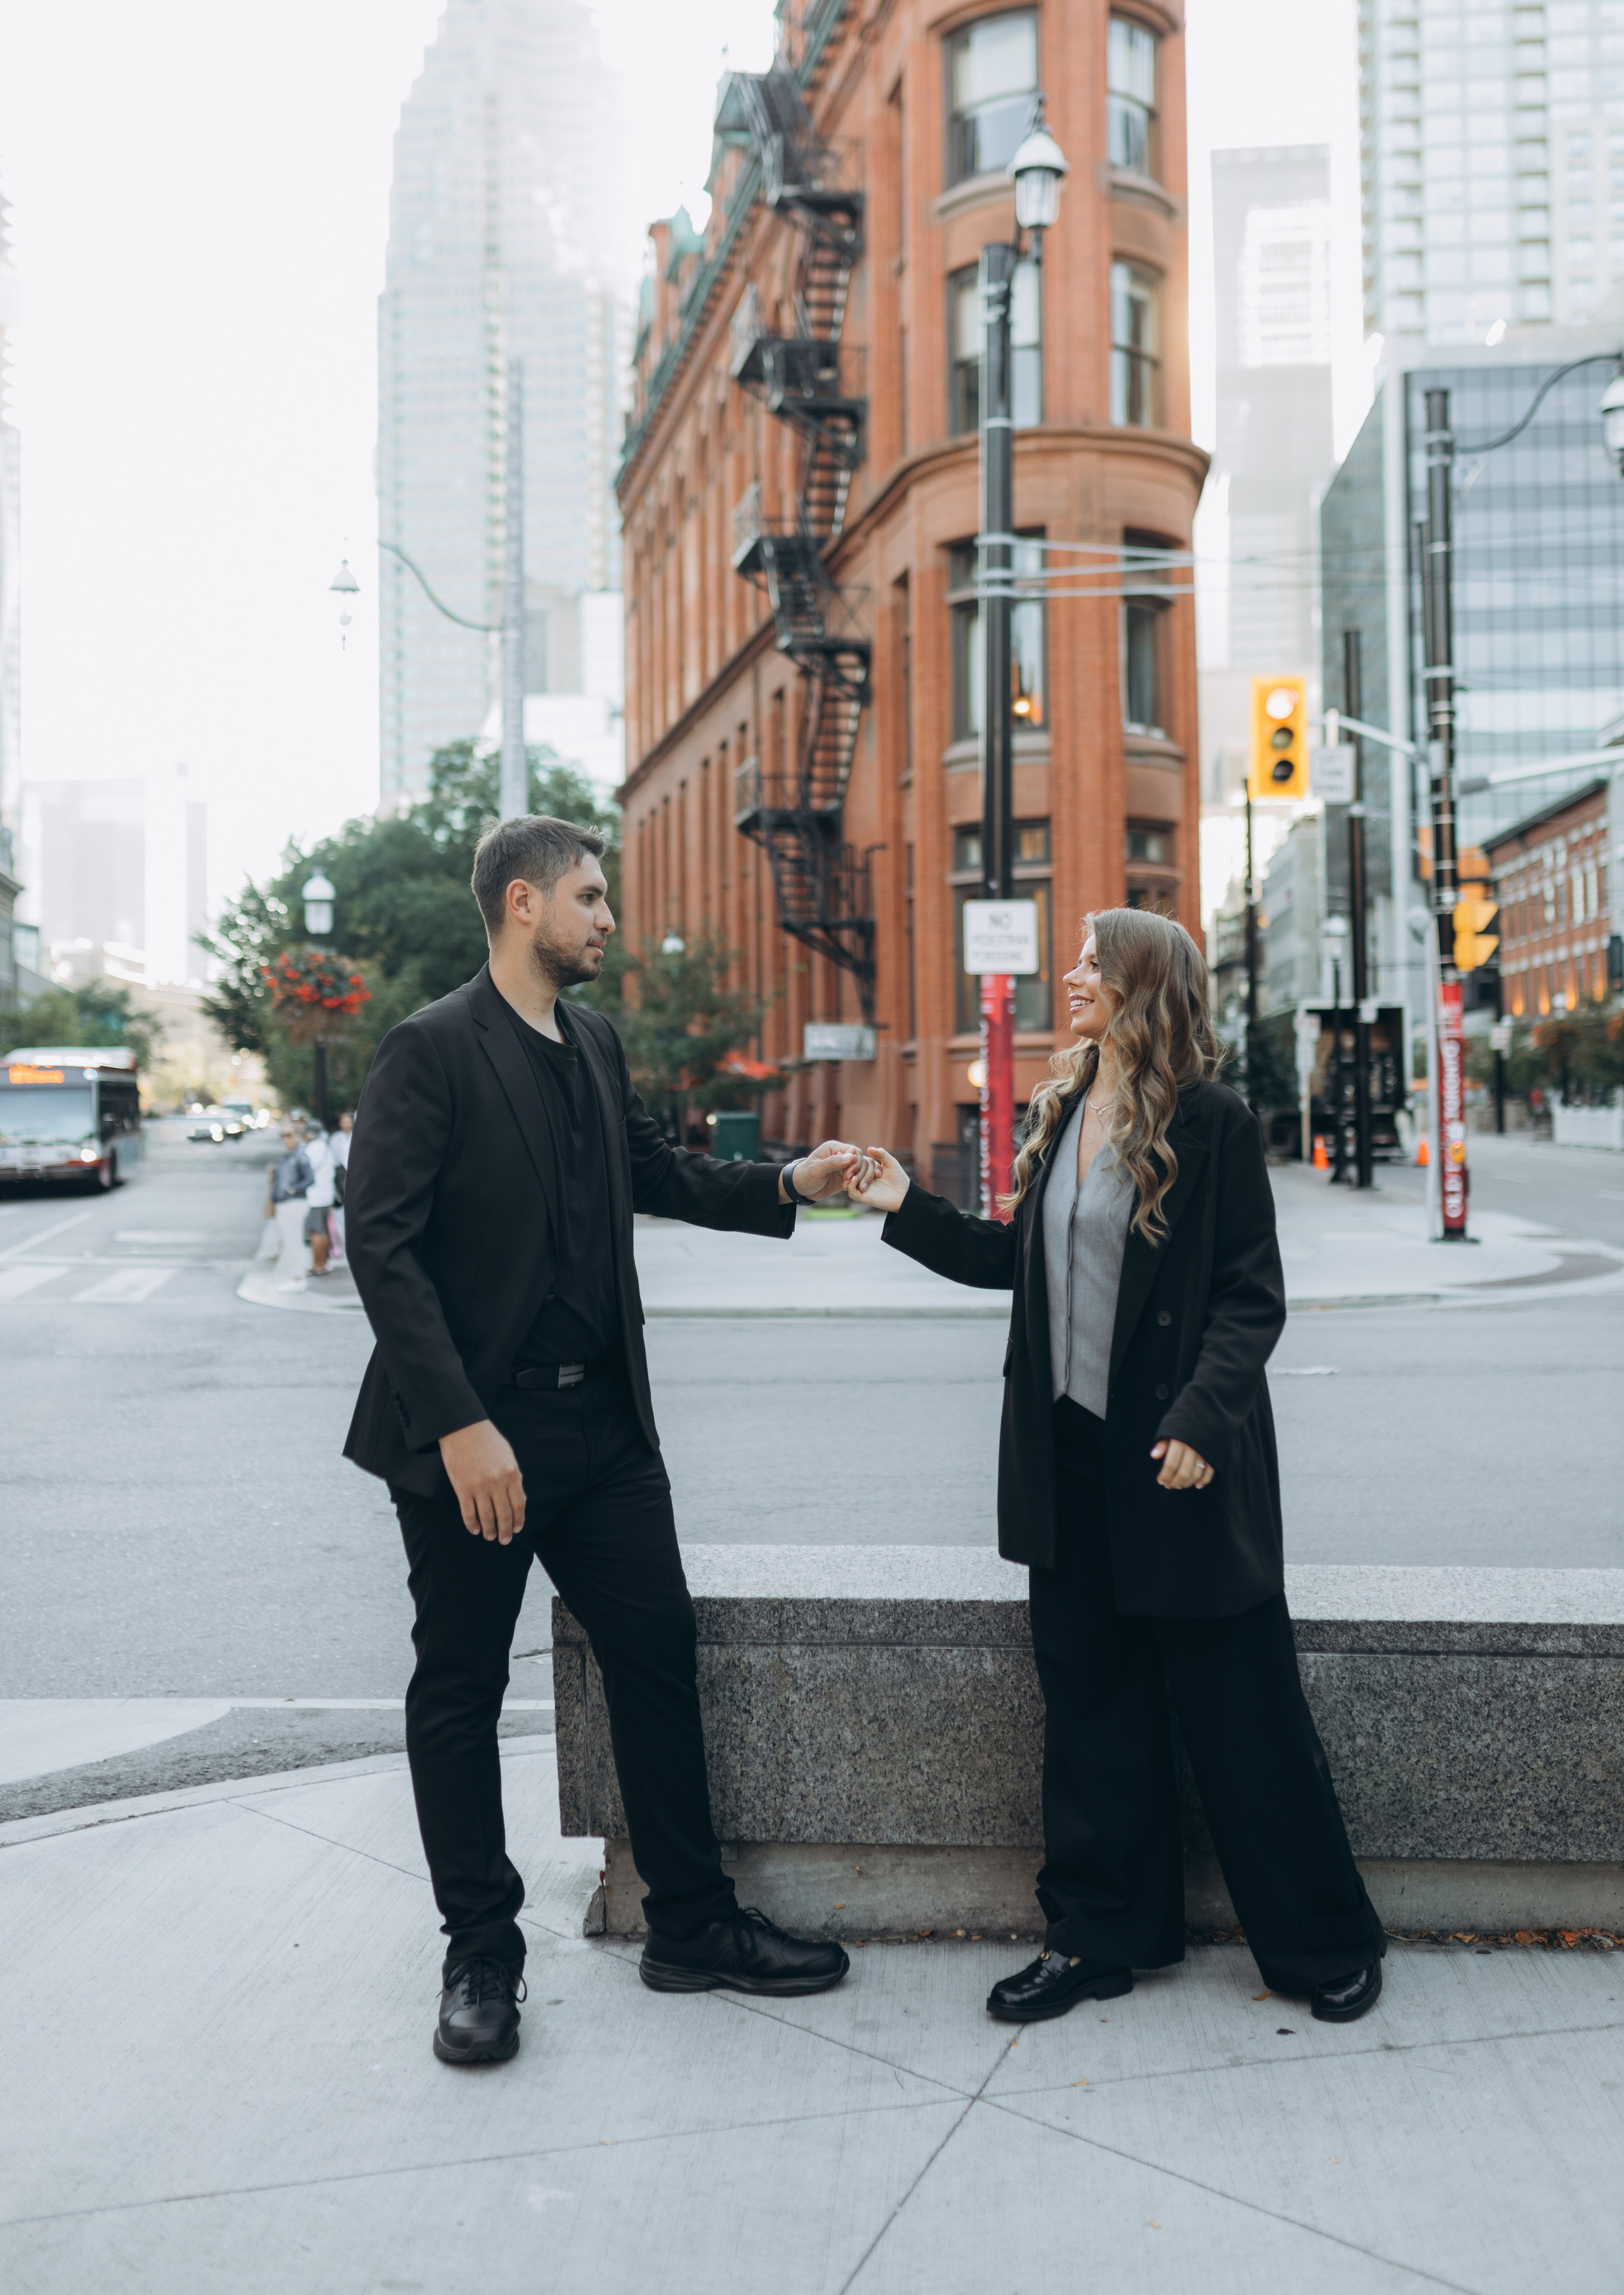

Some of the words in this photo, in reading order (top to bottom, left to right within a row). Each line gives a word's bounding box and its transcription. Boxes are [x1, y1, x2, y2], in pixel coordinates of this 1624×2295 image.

[988, 912, 1012, 931] NO
[1442, 1039, 1461, 1121] TORONTO
[1444, 1173, 1464, 1218] OLD
